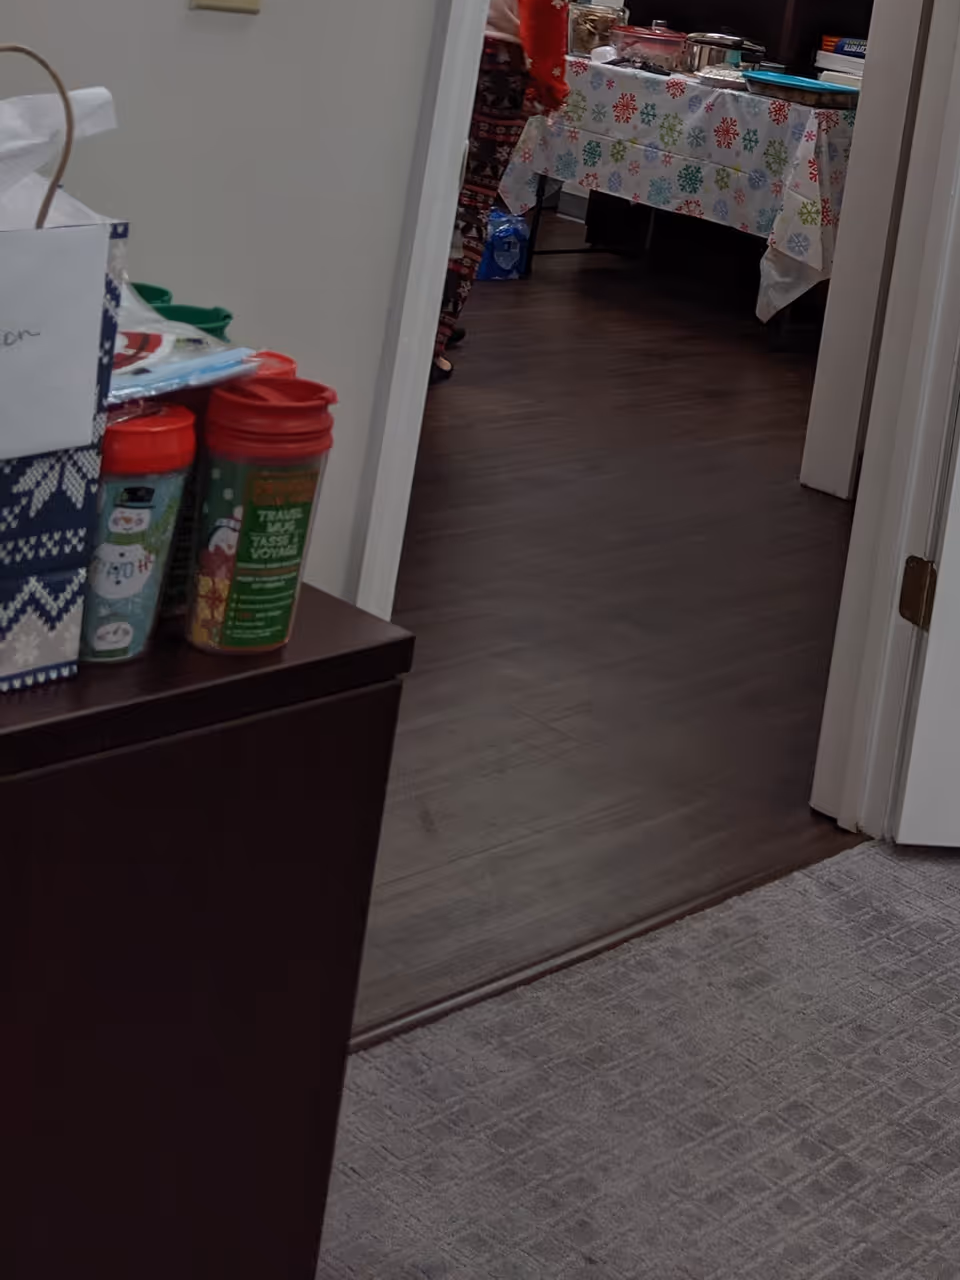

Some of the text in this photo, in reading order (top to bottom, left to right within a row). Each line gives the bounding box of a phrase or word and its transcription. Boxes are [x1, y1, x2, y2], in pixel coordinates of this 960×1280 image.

[0, 329, 41, 346] on
[257, 508, 303, 522] TRAVEL
[266, 521, 297, 533] MUG
[251, 534, 290, 548] TASSE
[250, 545, 298, 560] VOYAGE
